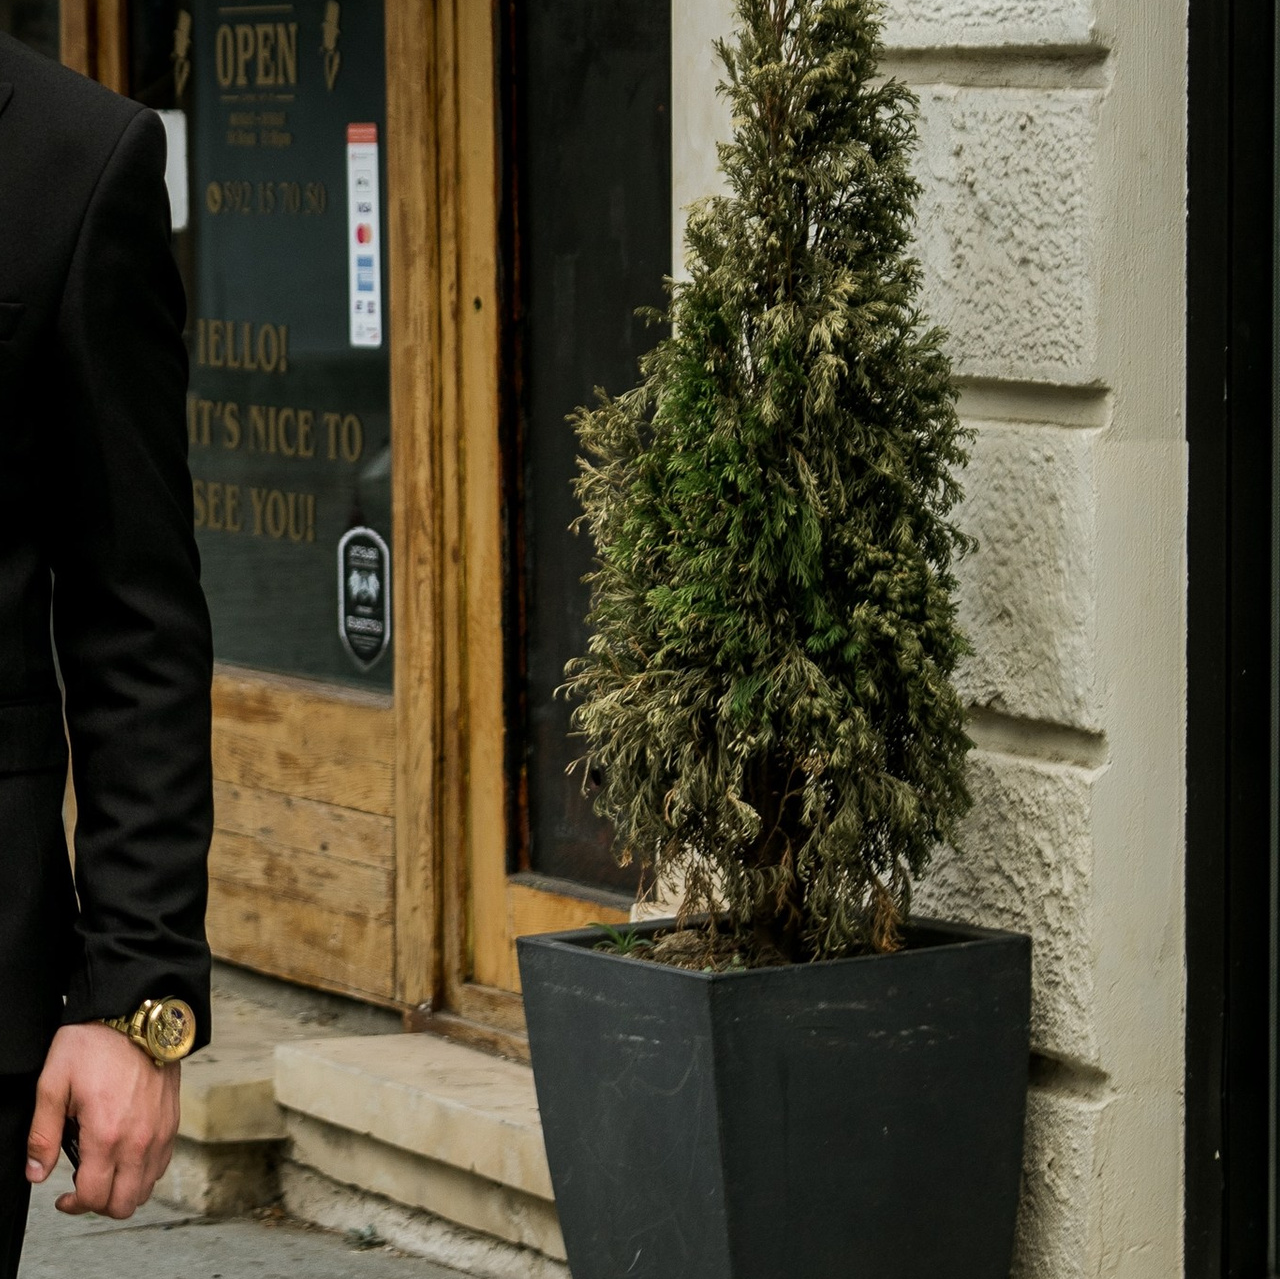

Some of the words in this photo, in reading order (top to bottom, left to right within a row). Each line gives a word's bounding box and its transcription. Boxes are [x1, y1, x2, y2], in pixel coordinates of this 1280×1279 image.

[215, 22, 298, 88] OPEN
[186, 394, 242, 450] IT'S
[248, 404, 316, 459] NICE
[323, 412, 363, 463] TO
[192, 480, 242, 533] SEE
[250, 487, 316, 544] YOU!
